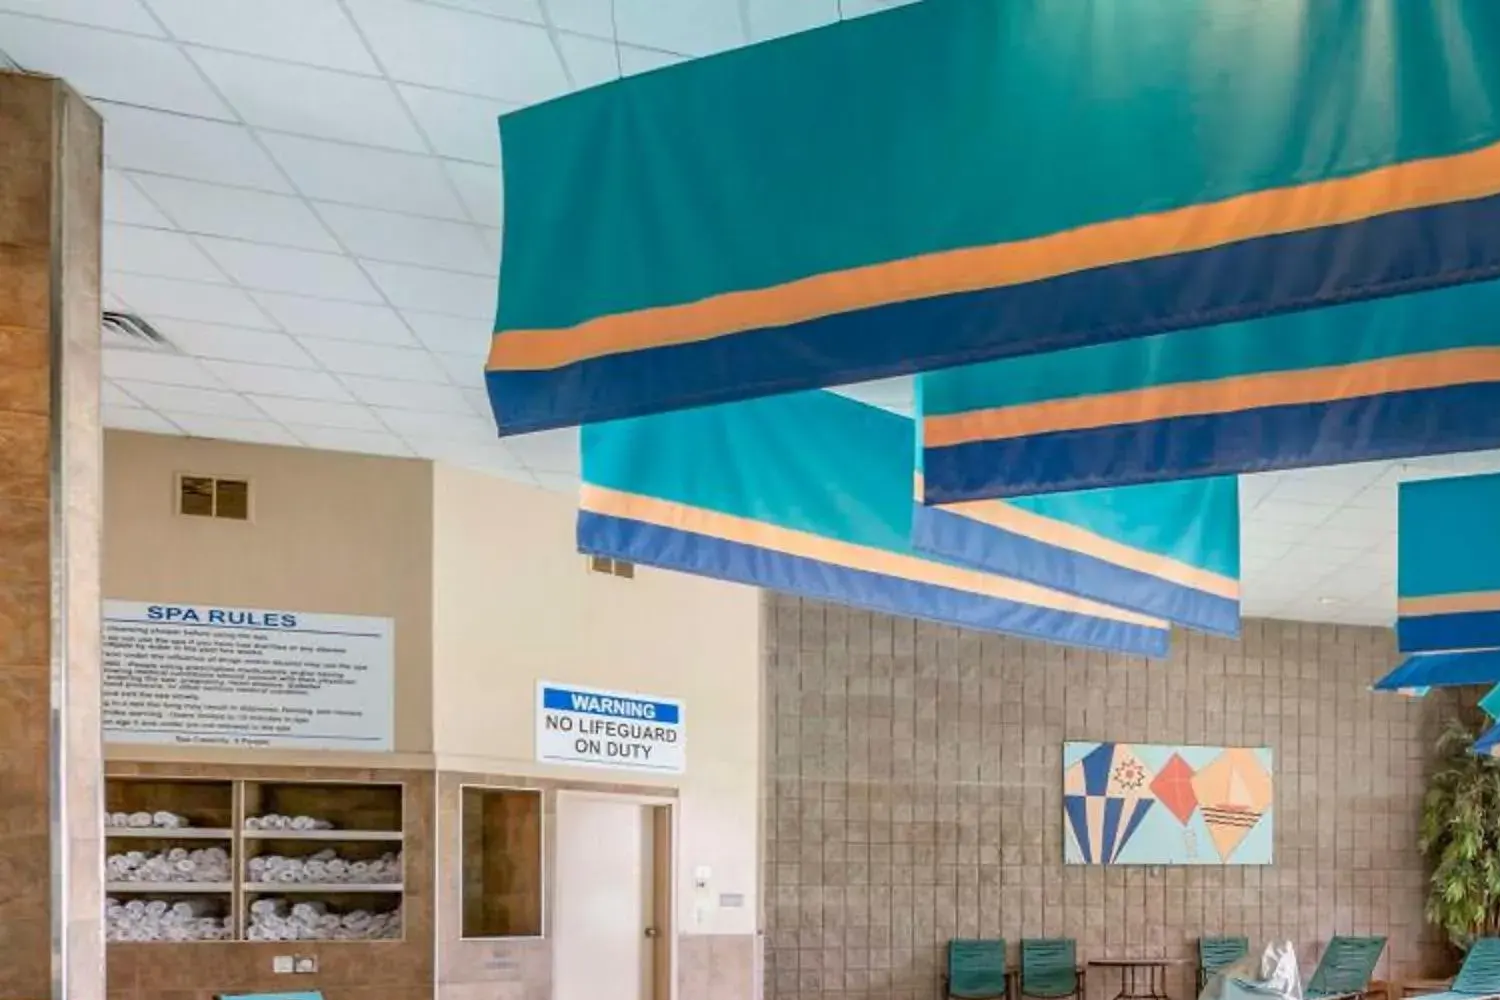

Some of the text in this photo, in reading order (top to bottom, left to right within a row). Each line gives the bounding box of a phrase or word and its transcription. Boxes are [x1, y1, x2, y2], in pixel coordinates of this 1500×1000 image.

[148, 606, 297, 627] SPA RULES
[571, 693, 656, 718] WARNING
[546, 715, 677, 743] NO LIFEGUARD
[575, 739, 652, 759] ON DUTY
